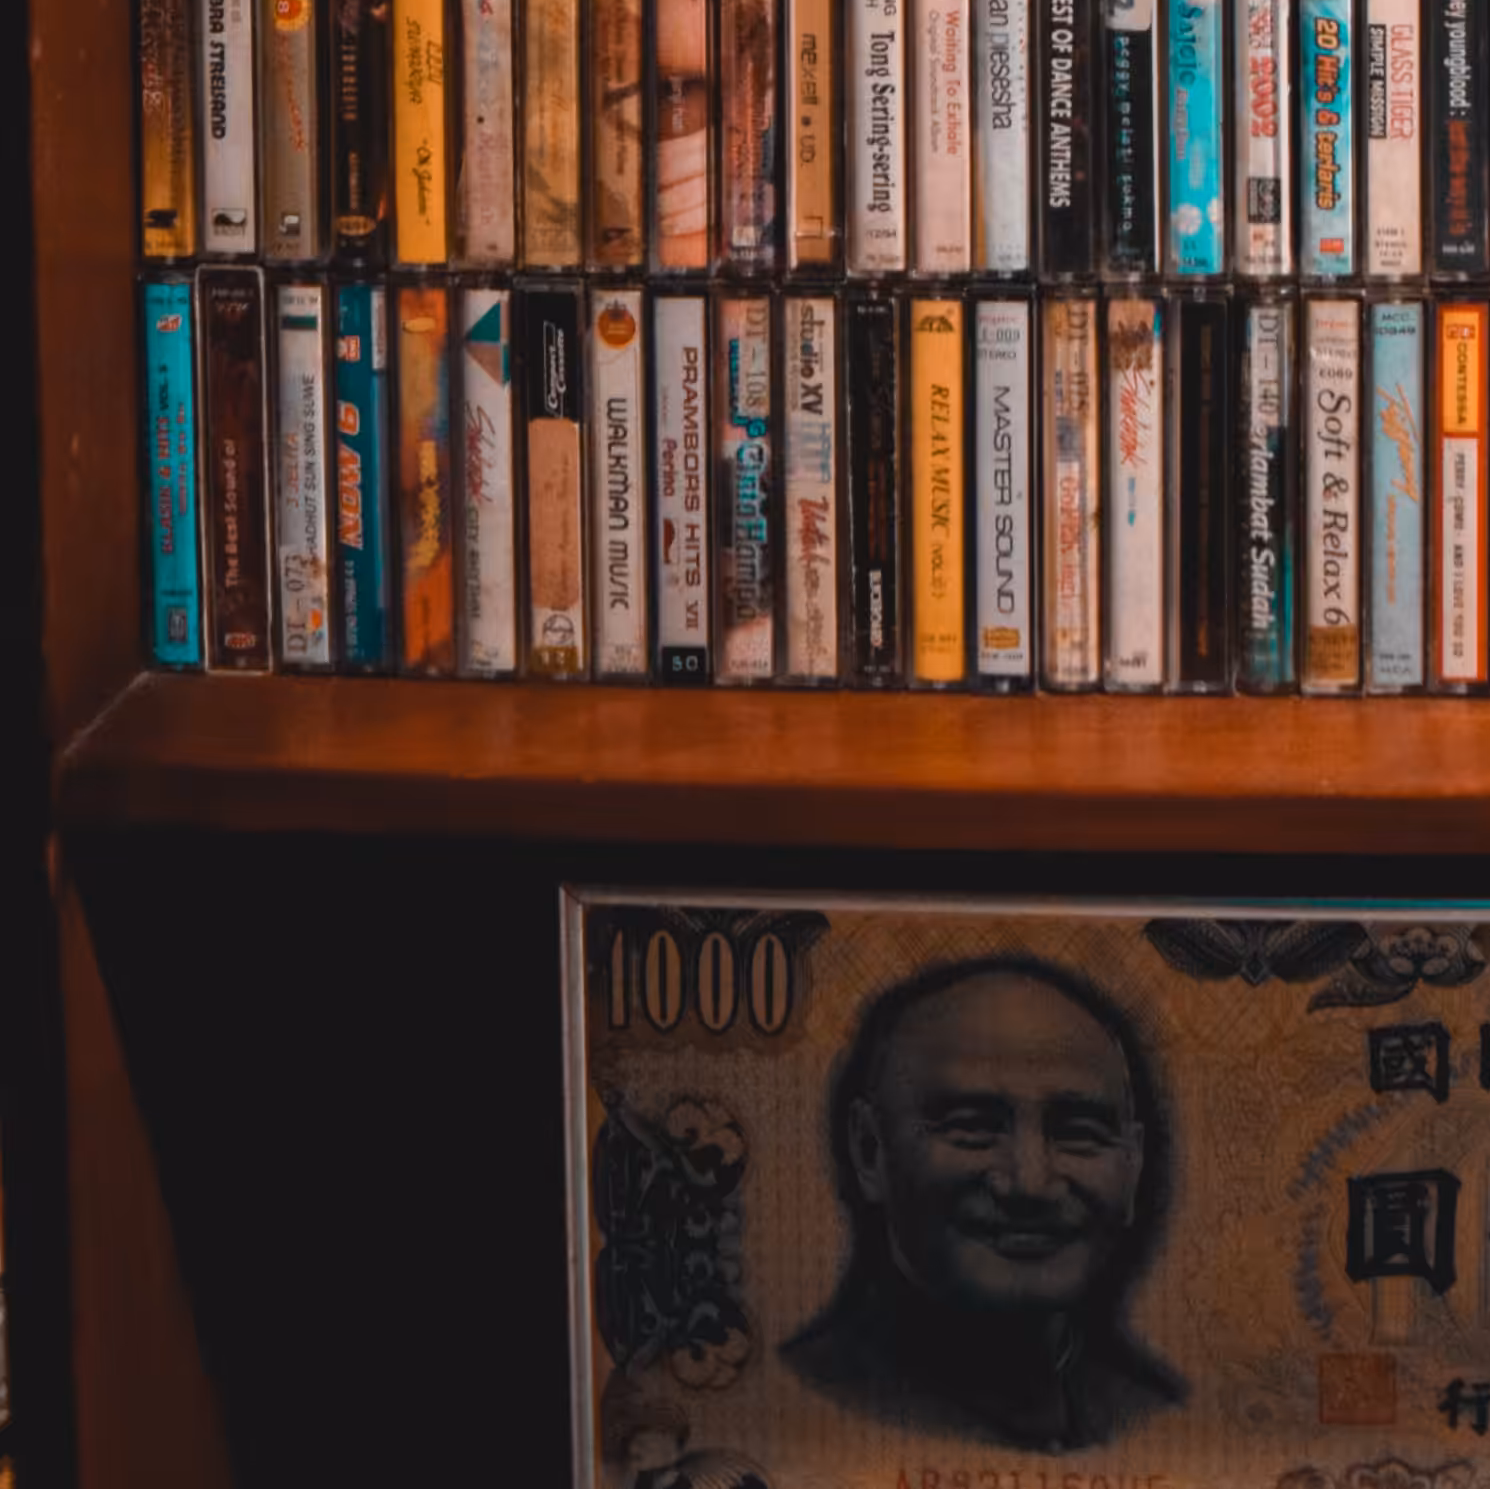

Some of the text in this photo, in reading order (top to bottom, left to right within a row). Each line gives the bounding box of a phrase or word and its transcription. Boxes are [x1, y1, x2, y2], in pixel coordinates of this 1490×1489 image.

[1049, 30, 1074, 53] OF
[1444, 23, 1468, 108] youngblood
[208, 40, 226, 140] STREISAND
[866, 31, 896, 213] Tong Sering-sering
[1049, 59, 1074, 118] DANCE
[1049, 123, 1074, 208] ANTHEMS
[684, 347, 700, 512] PRAMBORS
[1317, 389, 1351, 458] Soft
[606, 398, 629, 609] WALKMAN MUSIC
[992, 385, 1014, 613] MASTER SOUND
[684, 525, 700, 590] HITS
[1322, 508, 1350, 600] Relax
[1325, 606, 1351, 626] 6
[608, 928, 795, 1035] 1000
